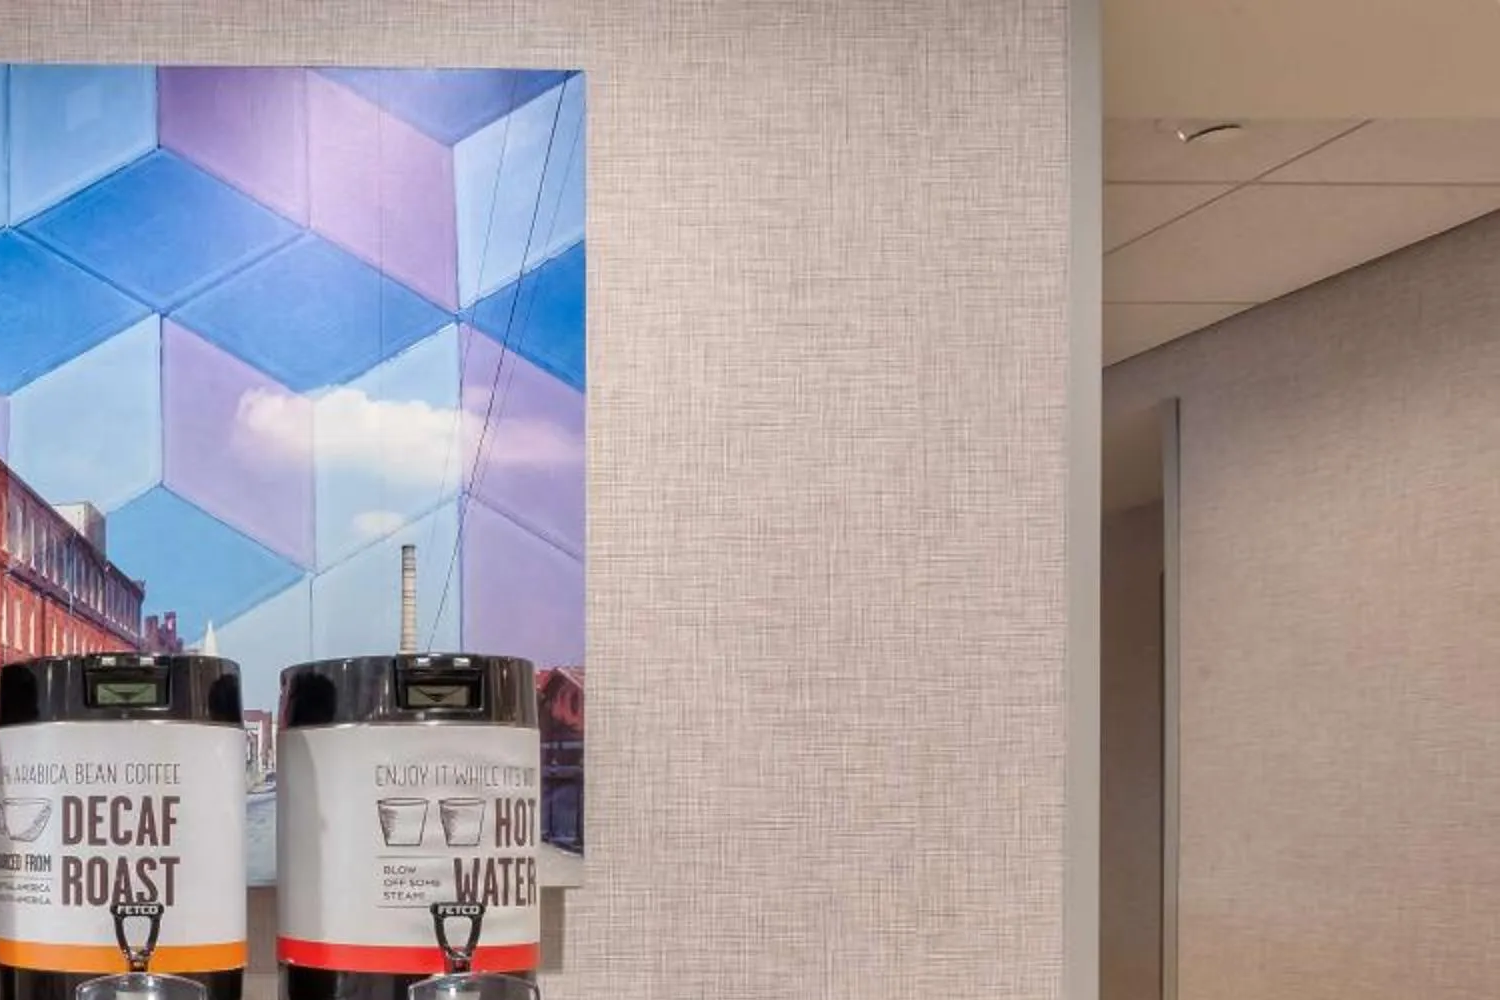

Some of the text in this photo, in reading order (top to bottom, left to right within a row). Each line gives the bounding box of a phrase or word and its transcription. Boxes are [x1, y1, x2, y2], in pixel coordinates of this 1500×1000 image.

[14, 763, 69, 785] ARABICA
[75, 763, 117, 785] BEAN
[125, 763, 181, 785] COFFEE
[375, 764, 430, 787] ENJOY
[435, 765, 449, 786] IT
[453, 765, 499, 787] WHILE
[62, 795, 181, 847] DECAF
[495, 797, 536, 848] HOT
[25, 854, 52, 873] FROM
[383, 865, 417, 875] BLOW
[62, 855, 181, 907] ROAST
[383, 879, 406, 887] OFF
[454, 857, 537, 906] WATER
[383, 891, 425, 900] STEAM
[117, 904, 160, 915] FETCO
